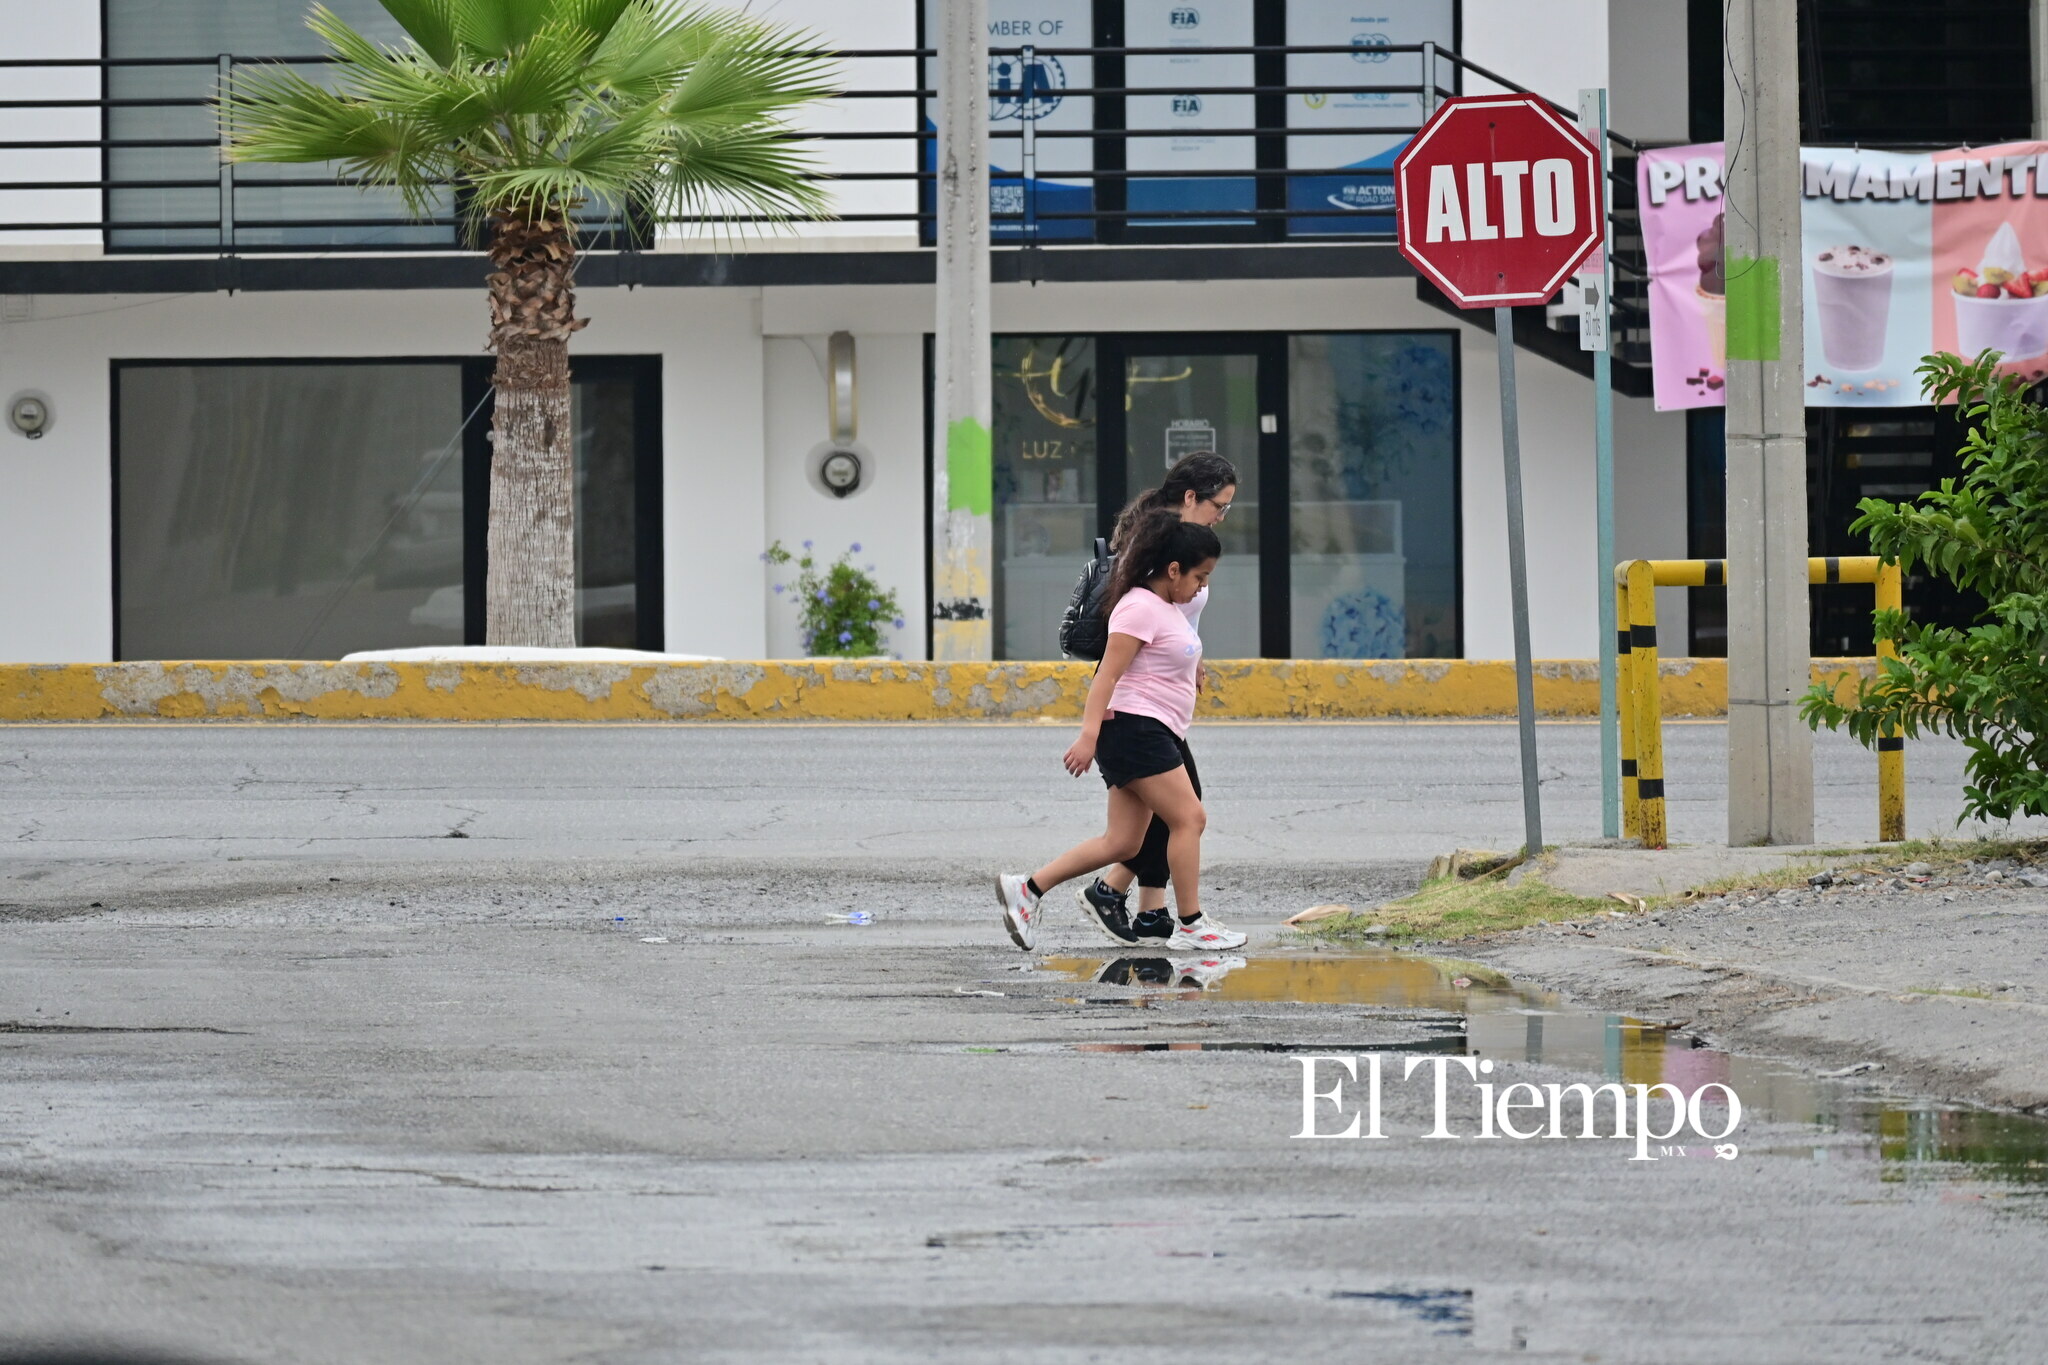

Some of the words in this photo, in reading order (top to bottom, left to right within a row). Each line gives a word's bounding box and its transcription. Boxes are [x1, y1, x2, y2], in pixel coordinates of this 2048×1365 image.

[988, 20, 1031, 36] MBER
[1038, 20, 1064, 36] OF
[1649, 152, 2048, 206] PRMAMENT
[1358, 186, 1395, 195] ACTION
[1426, 158, 1577, 243] ALTO
[1023, 441, 1063, 459] LUZ
